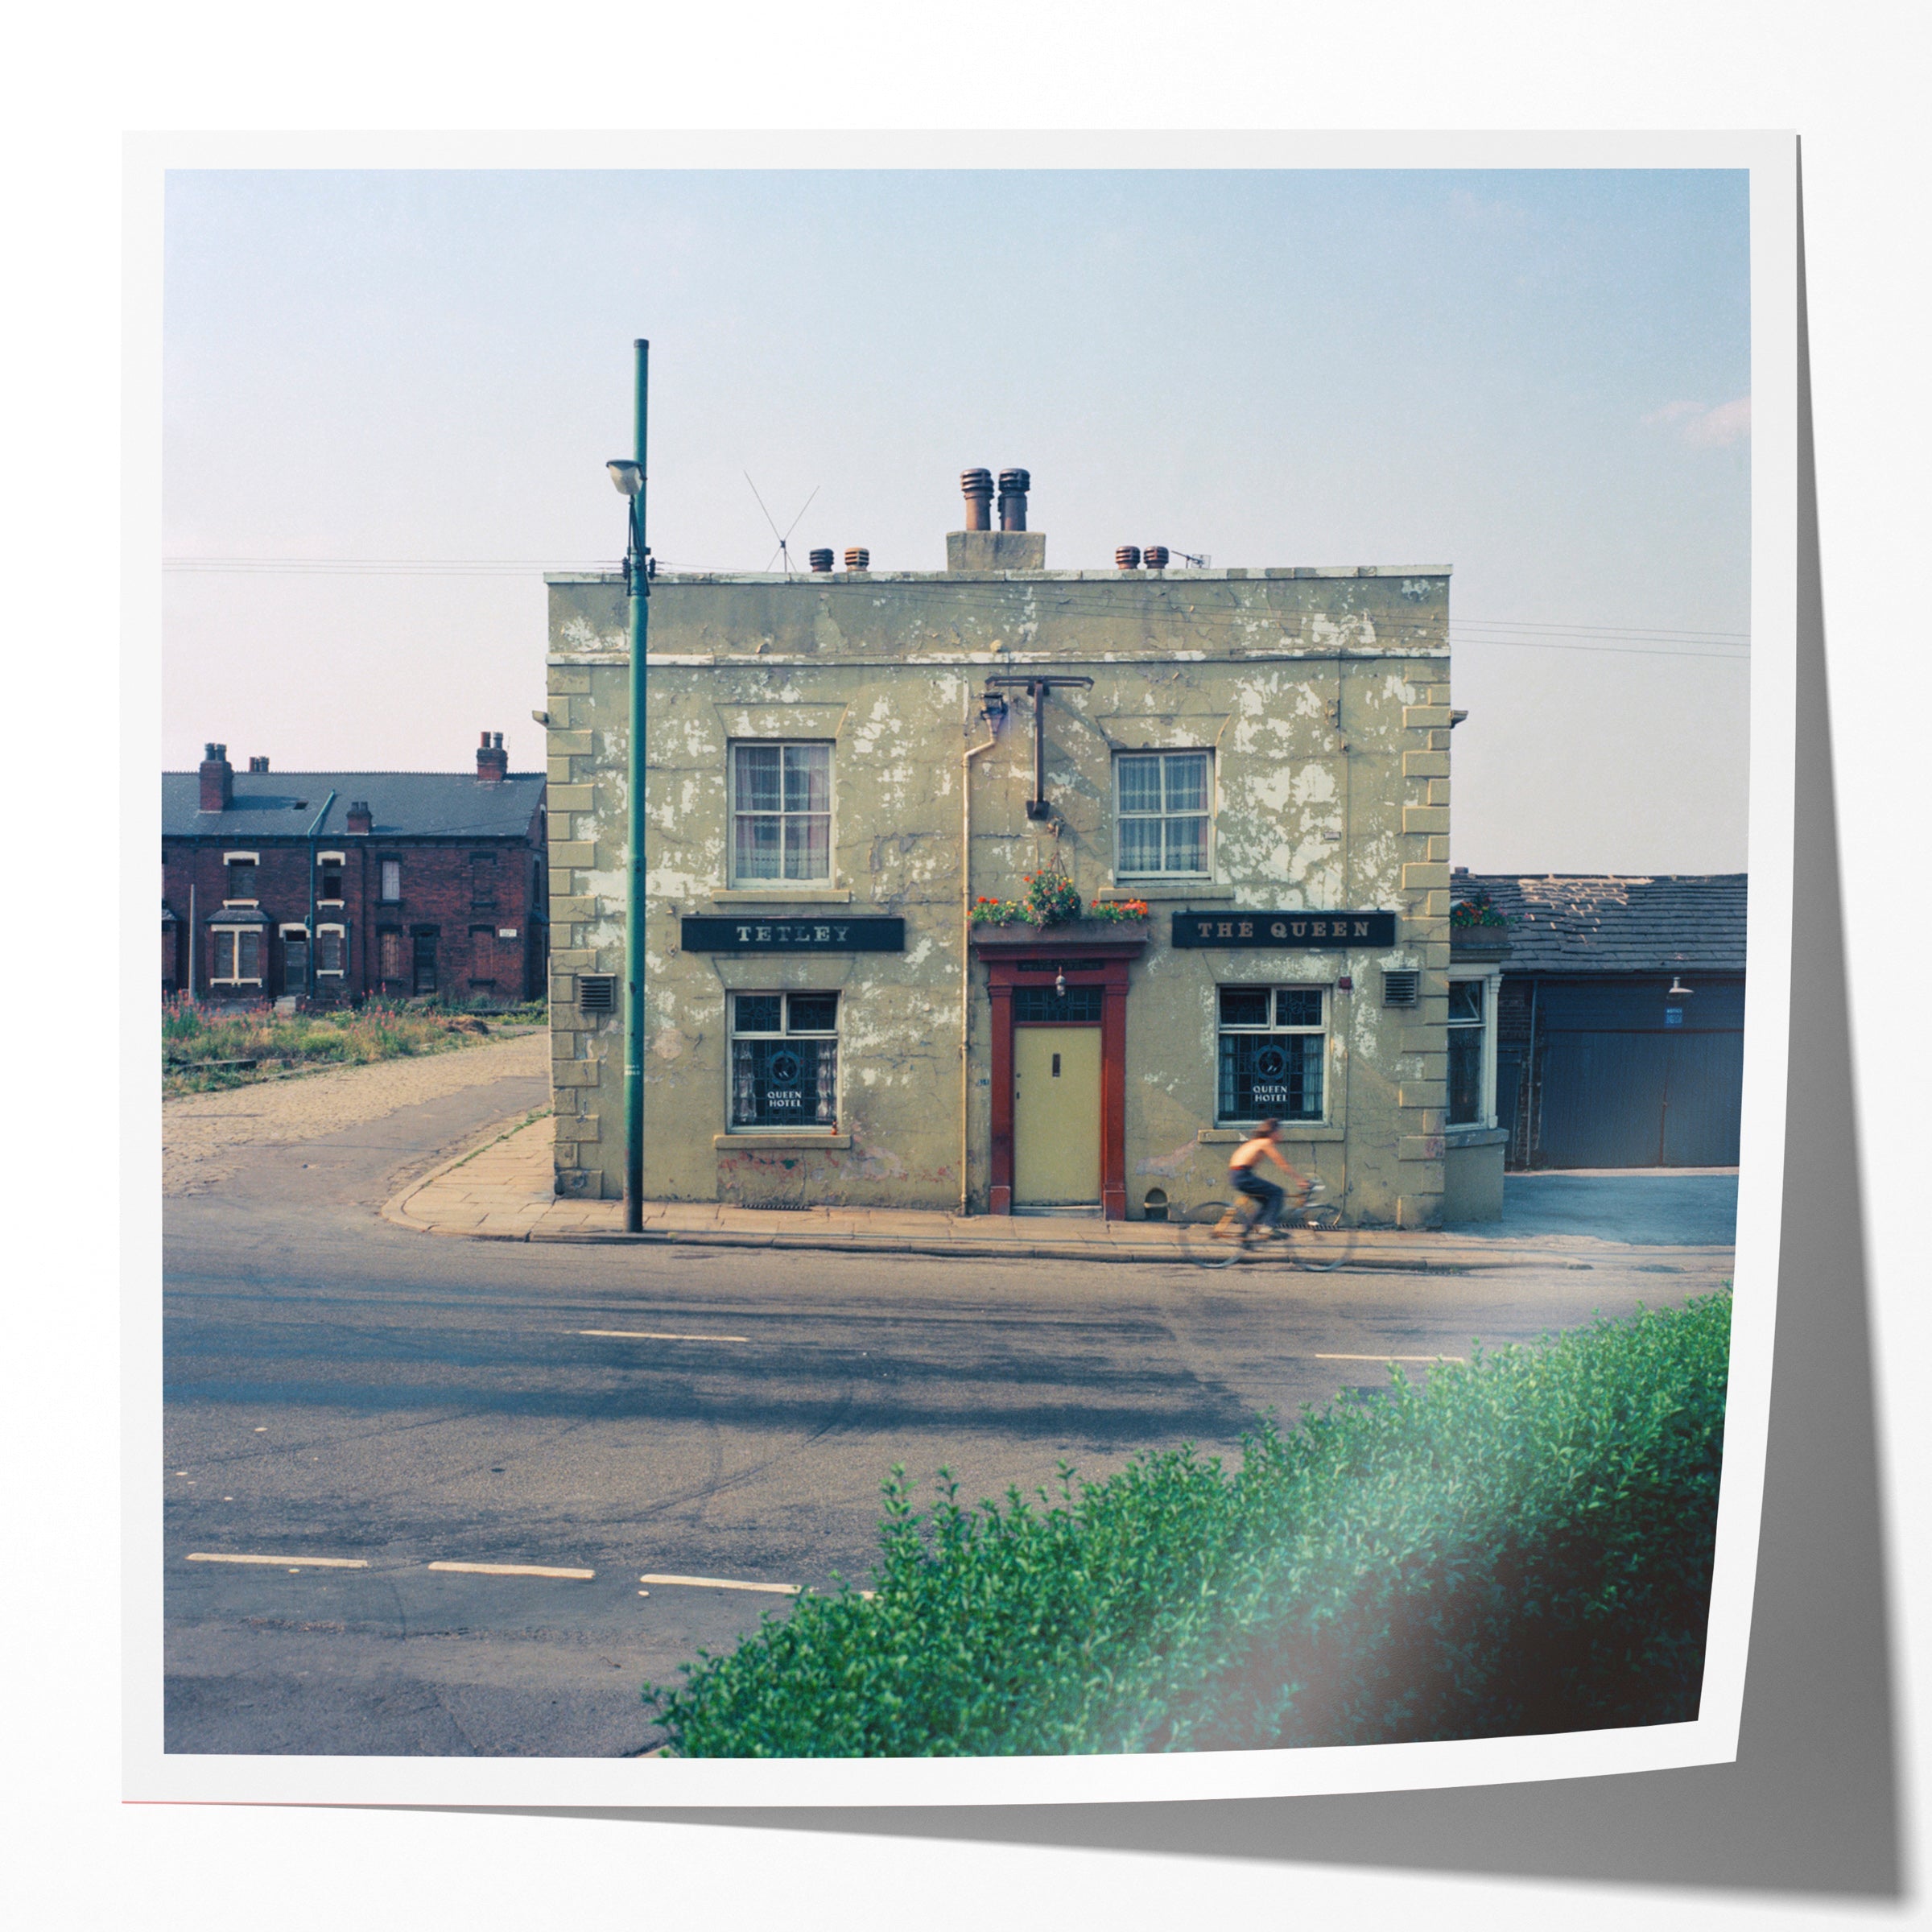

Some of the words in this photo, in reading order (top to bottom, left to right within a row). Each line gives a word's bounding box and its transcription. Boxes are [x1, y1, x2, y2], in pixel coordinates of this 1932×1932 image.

[736, 926, 850, 942] TETLEY
[1197, 922, 1253, 938] THE
[1270, 921, 1369, 939] QUEEN
[1253, 1085, 1288, 1093] QUEEN
[766, 1091, 802, 1099] QUEEN
[1254, 1094, 1288, 1102] HOTEL
